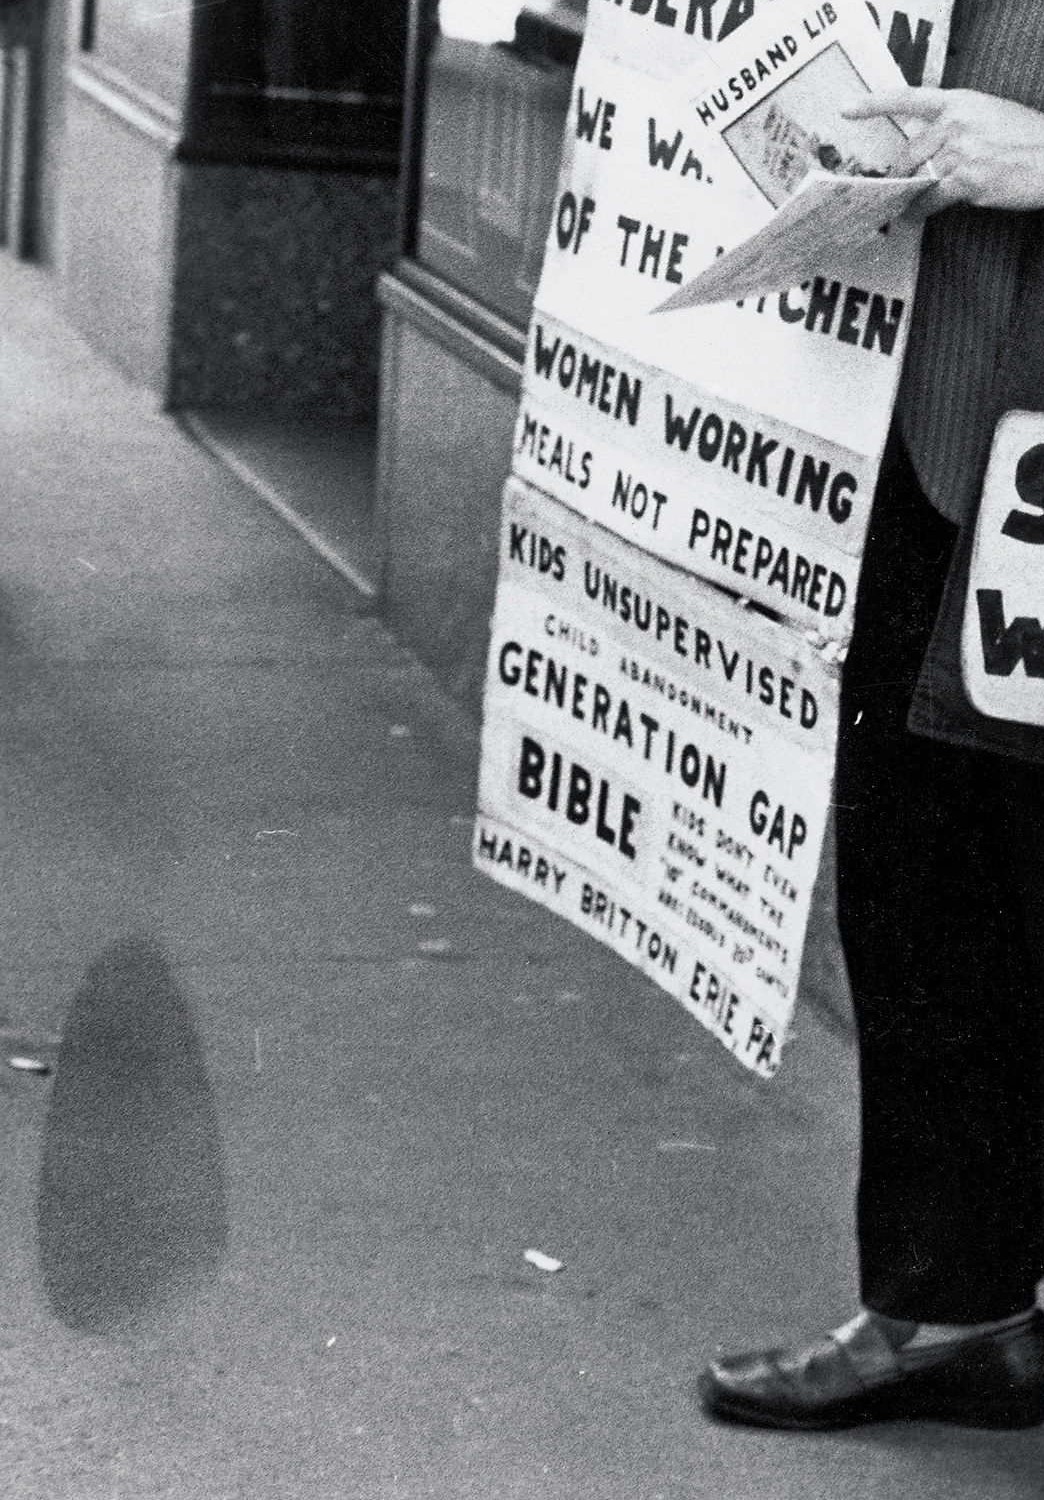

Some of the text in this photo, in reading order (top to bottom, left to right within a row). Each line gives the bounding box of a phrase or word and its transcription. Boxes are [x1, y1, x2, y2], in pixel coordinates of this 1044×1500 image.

[577, 87, 616, 151] WE
[696, 2, 838, 126] HUSBAND LIB
[557, 191, 595, 255] OF
[617, 215, 689, 284] THE
[534, 324, 857, 524] WOMEN WORKING
[519, 411, 847, 618] MEALS NOT PREPARED
[509, 523, 818, 730] KIDS UNSUPERVISED
[543, 613, 753, 744] CHILD ABANDONMENT
[500, 641, 807, 860] GENERATION GAP
[518, 736, 641, 860] BIBLE
[479, 826, 566, 894] HARRY
[580, 883, 677, 974] BRITTON
